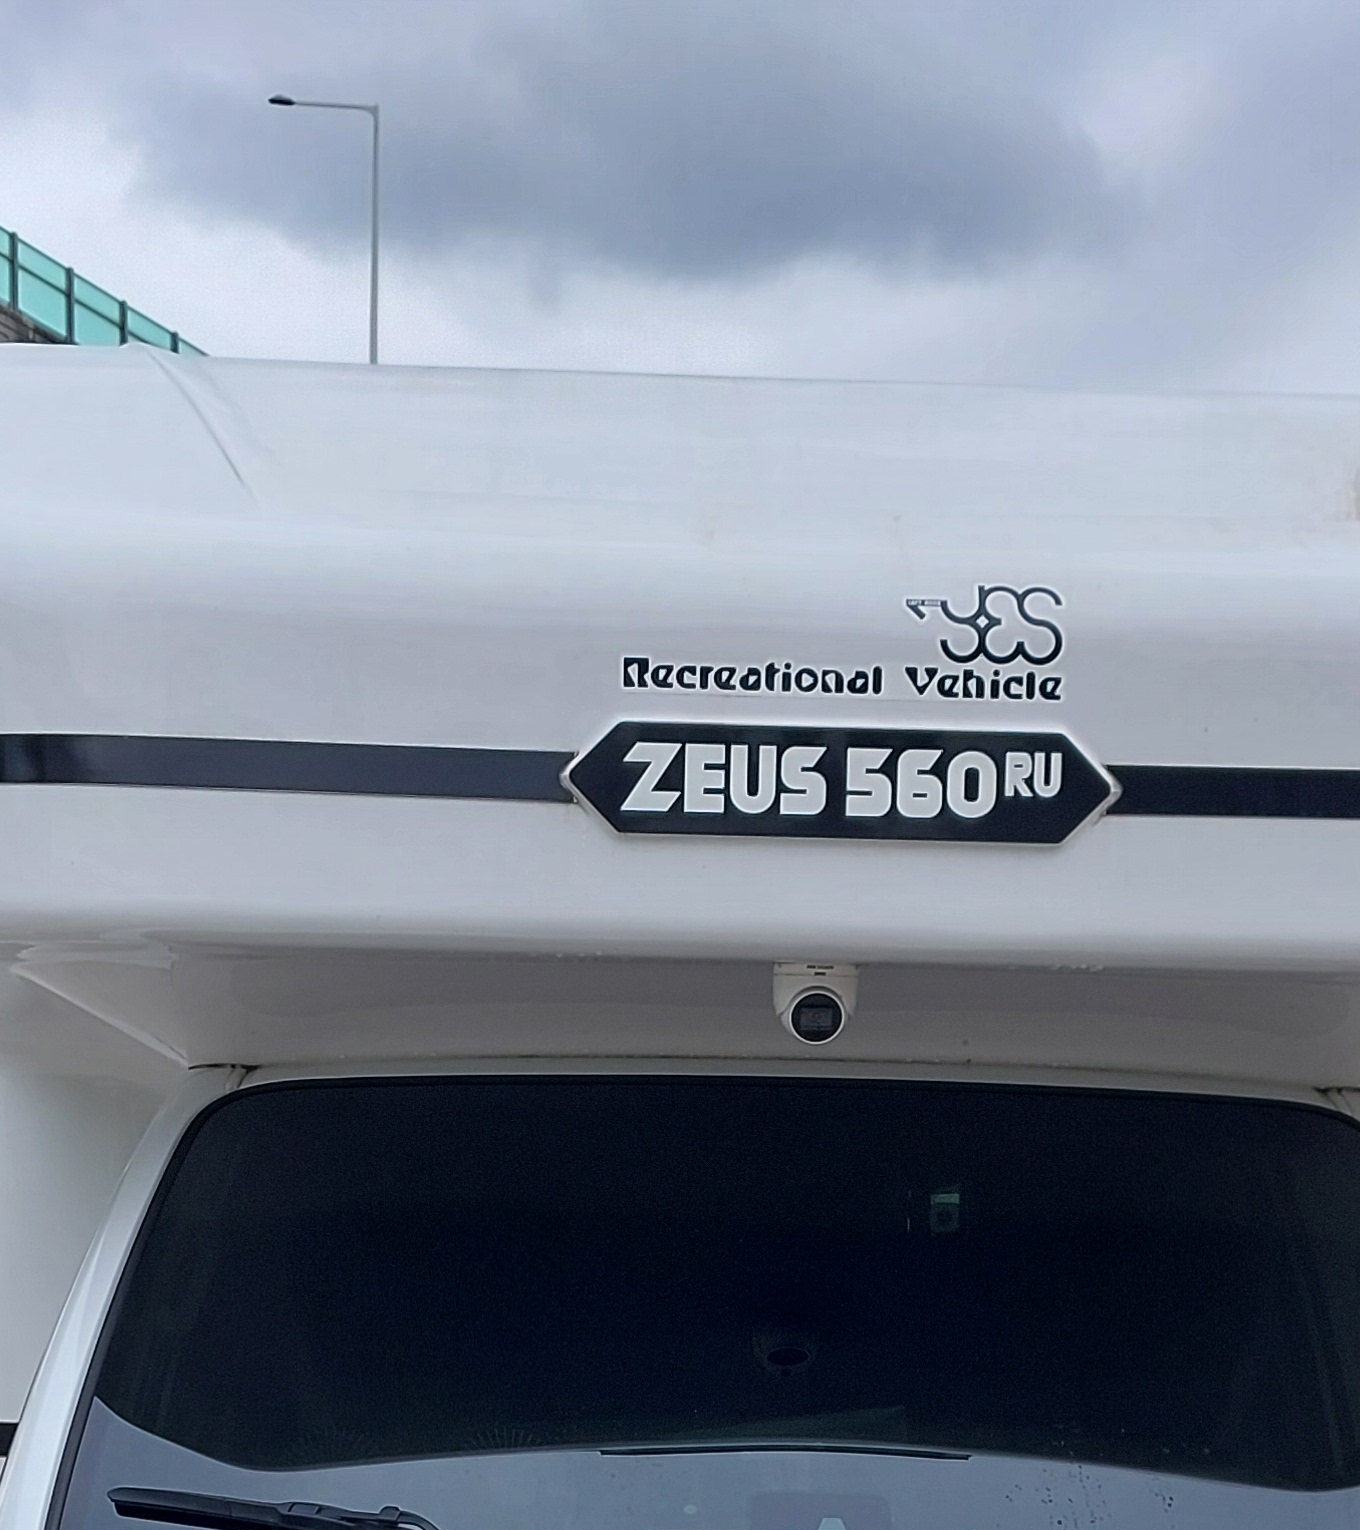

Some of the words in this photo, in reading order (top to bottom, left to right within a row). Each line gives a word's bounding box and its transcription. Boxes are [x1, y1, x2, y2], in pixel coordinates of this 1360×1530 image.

[623, 657, 882, 695] Recreational
[904, 666, 1062, 700] Vehicle
[619, 741, 827, 815] ZEUS
